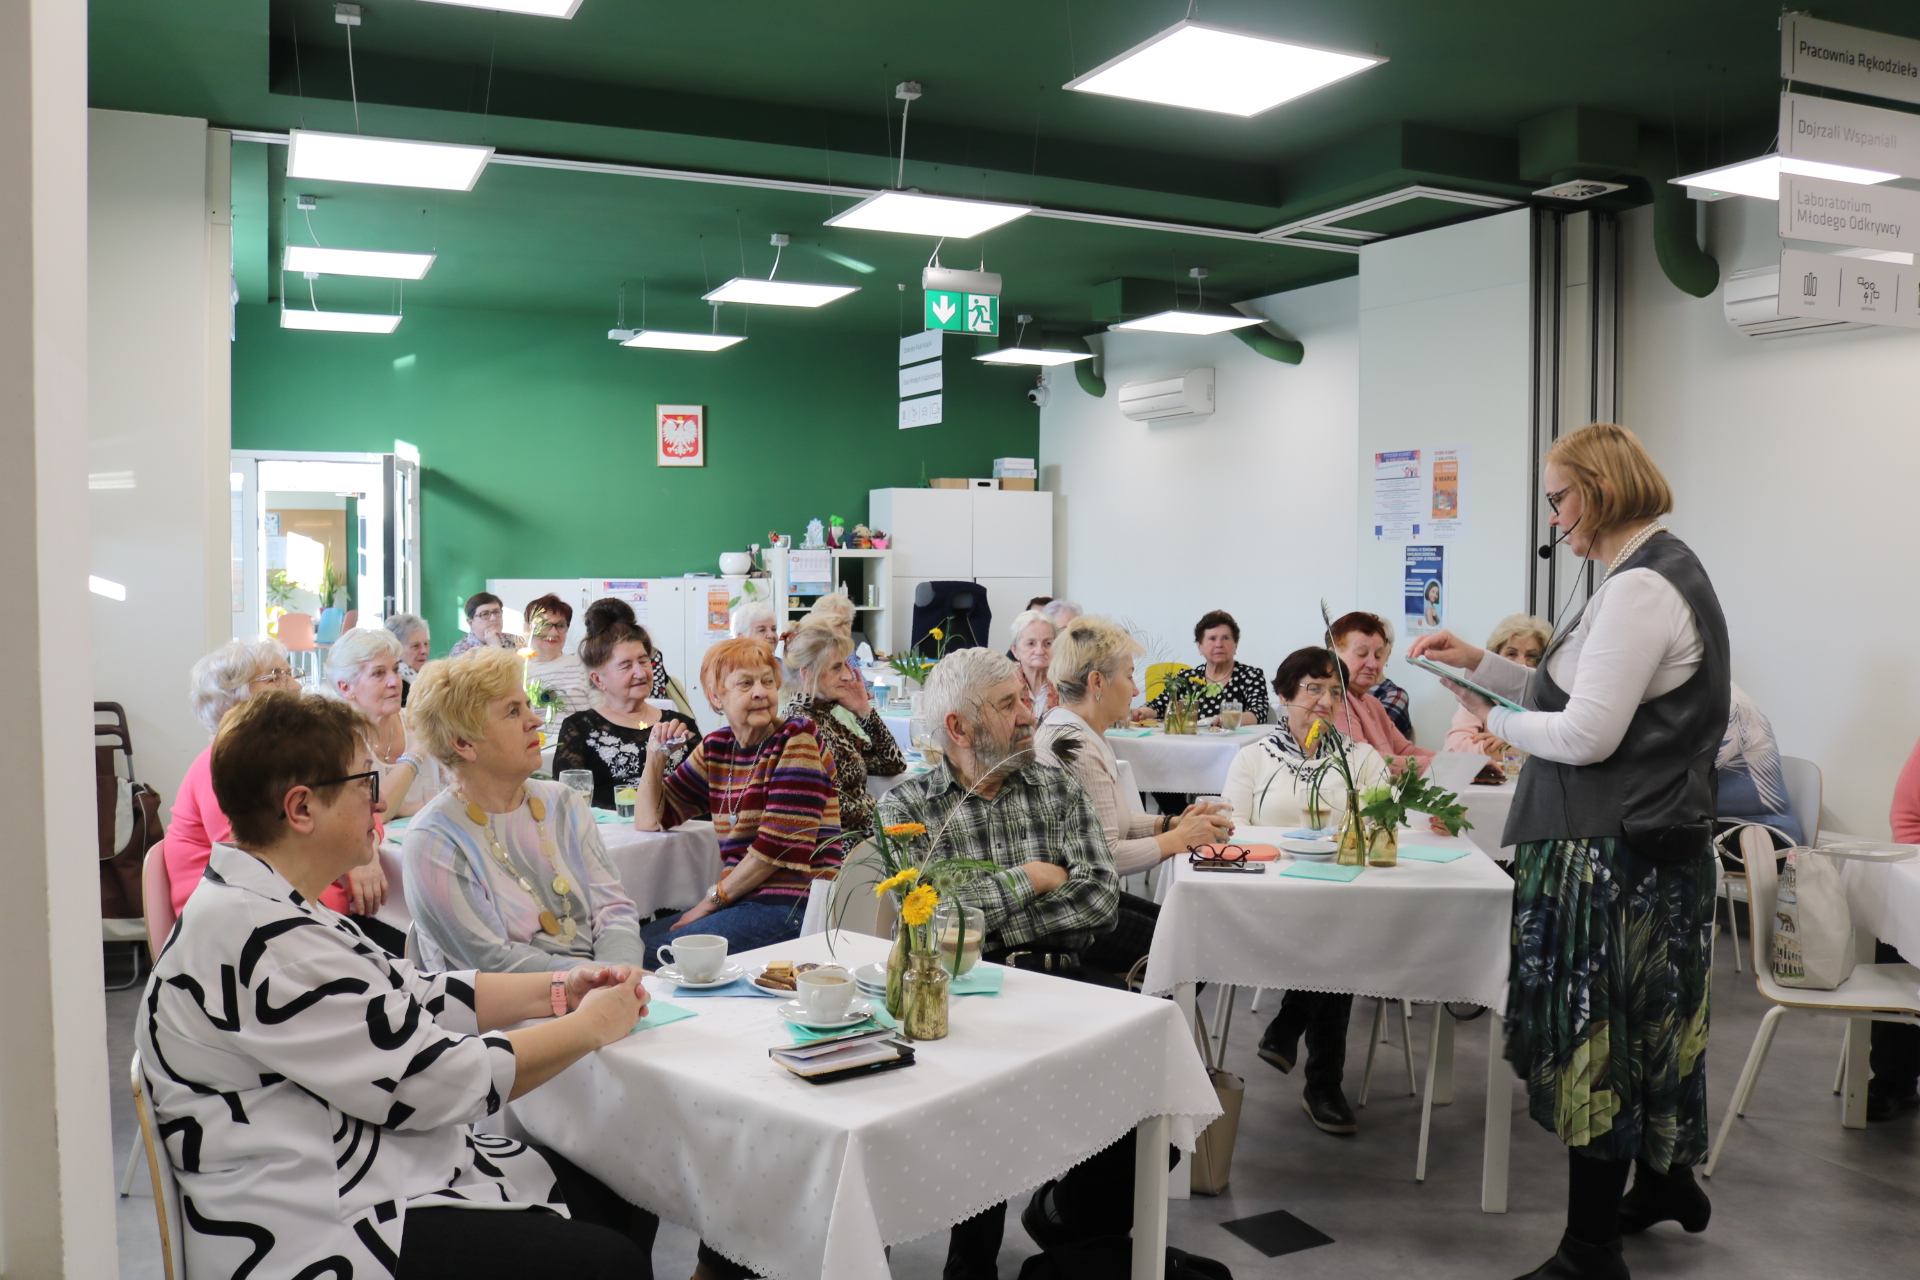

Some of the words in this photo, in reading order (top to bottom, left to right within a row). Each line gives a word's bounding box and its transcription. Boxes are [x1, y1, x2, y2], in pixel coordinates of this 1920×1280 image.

[1799, 40, 1855, 66] Pracownia
[1858, 53, 1918, 78] Rękodzieła
[1798, 119, 1840, 140] Dojrzali
[1843, 126, 1897, 149] Wspaniali
[1797, 190, 1872, 214] Laboratorium
[1797, 208, 1846, 231] Młodego
[1849, 215, 1901, 238] Odkrywcy
